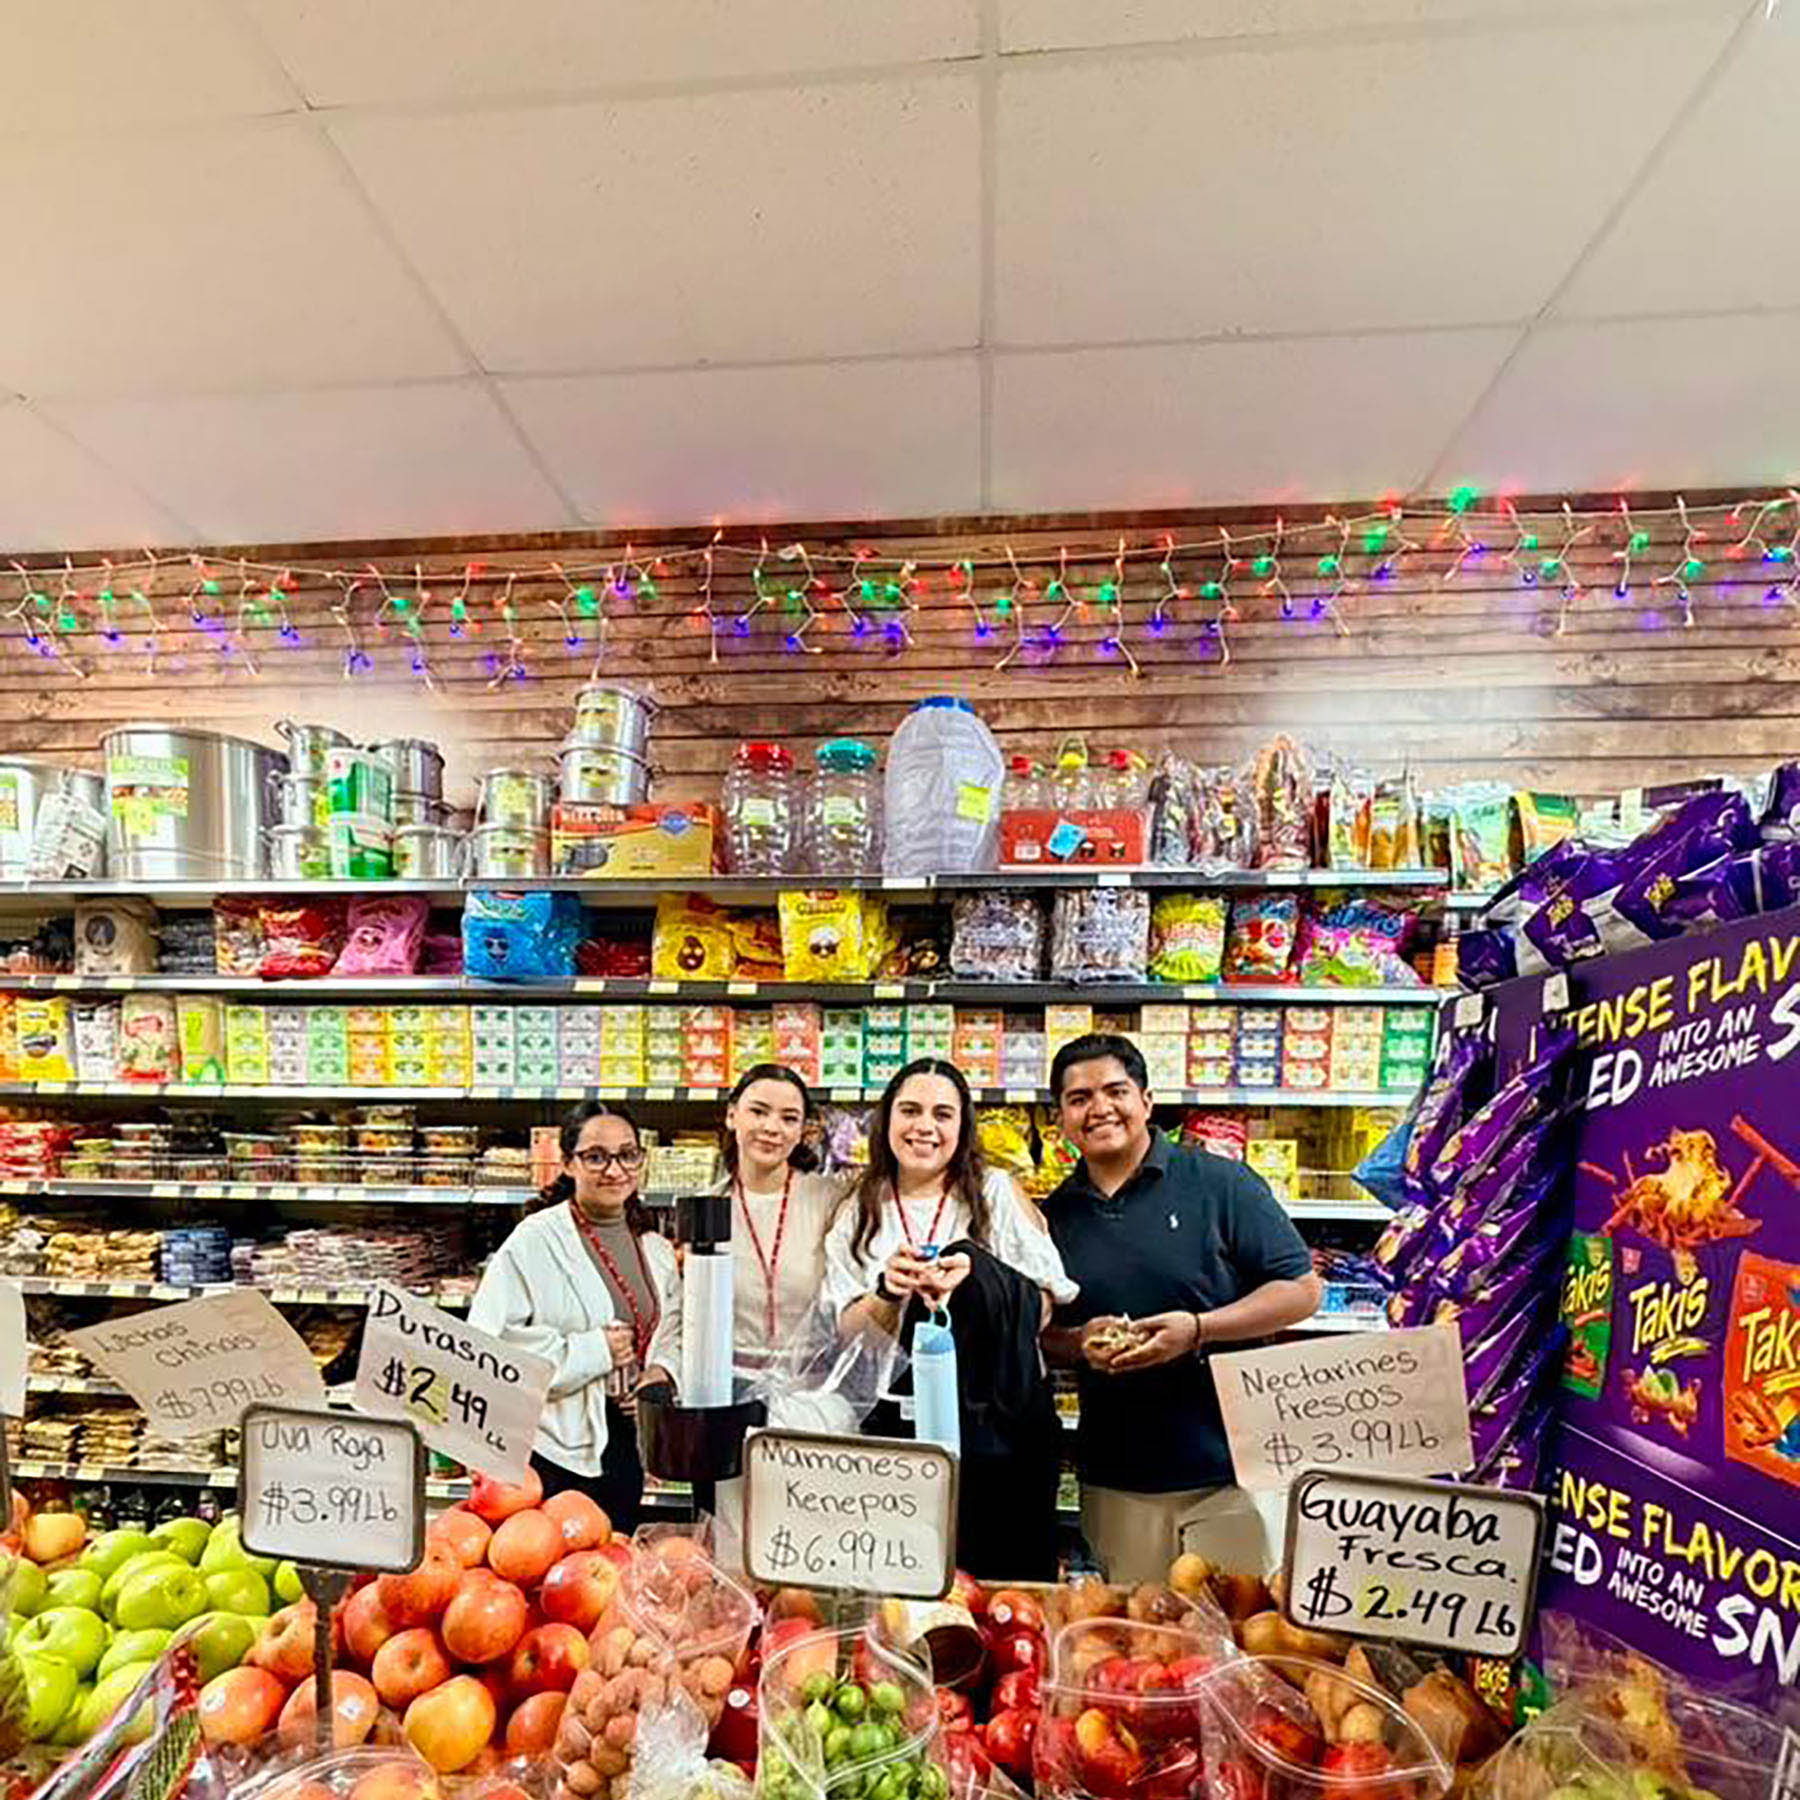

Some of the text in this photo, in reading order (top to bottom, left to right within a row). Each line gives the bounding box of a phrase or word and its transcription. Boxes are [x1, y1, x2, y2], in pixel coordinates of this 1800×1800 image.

[1659, 1003, 1757, 1057] INTO AN
[1649, 1034, 1762, 1088] AWESOME
[1561, 1260, 1611, 1314] akis
[372, 1290, 519, 1383] Durasno
[1629, 1277, 1709, 1355] Takis
[1739, 1307, 1800, 1383] Tak
[1241, 1351, 1418, 1397] Nectarines
[262, 1420, 310, 1451] Uva
[761, 1439, 913, 1481] Mamones
[786, 1480, 917, 1522] Kenepas
[1300, 1478, 1500, 1545] Guayaba
[1617, 1547, 1705, 1605] INTO AN
[1607, 1571, 1709, 1639] AWESOME
